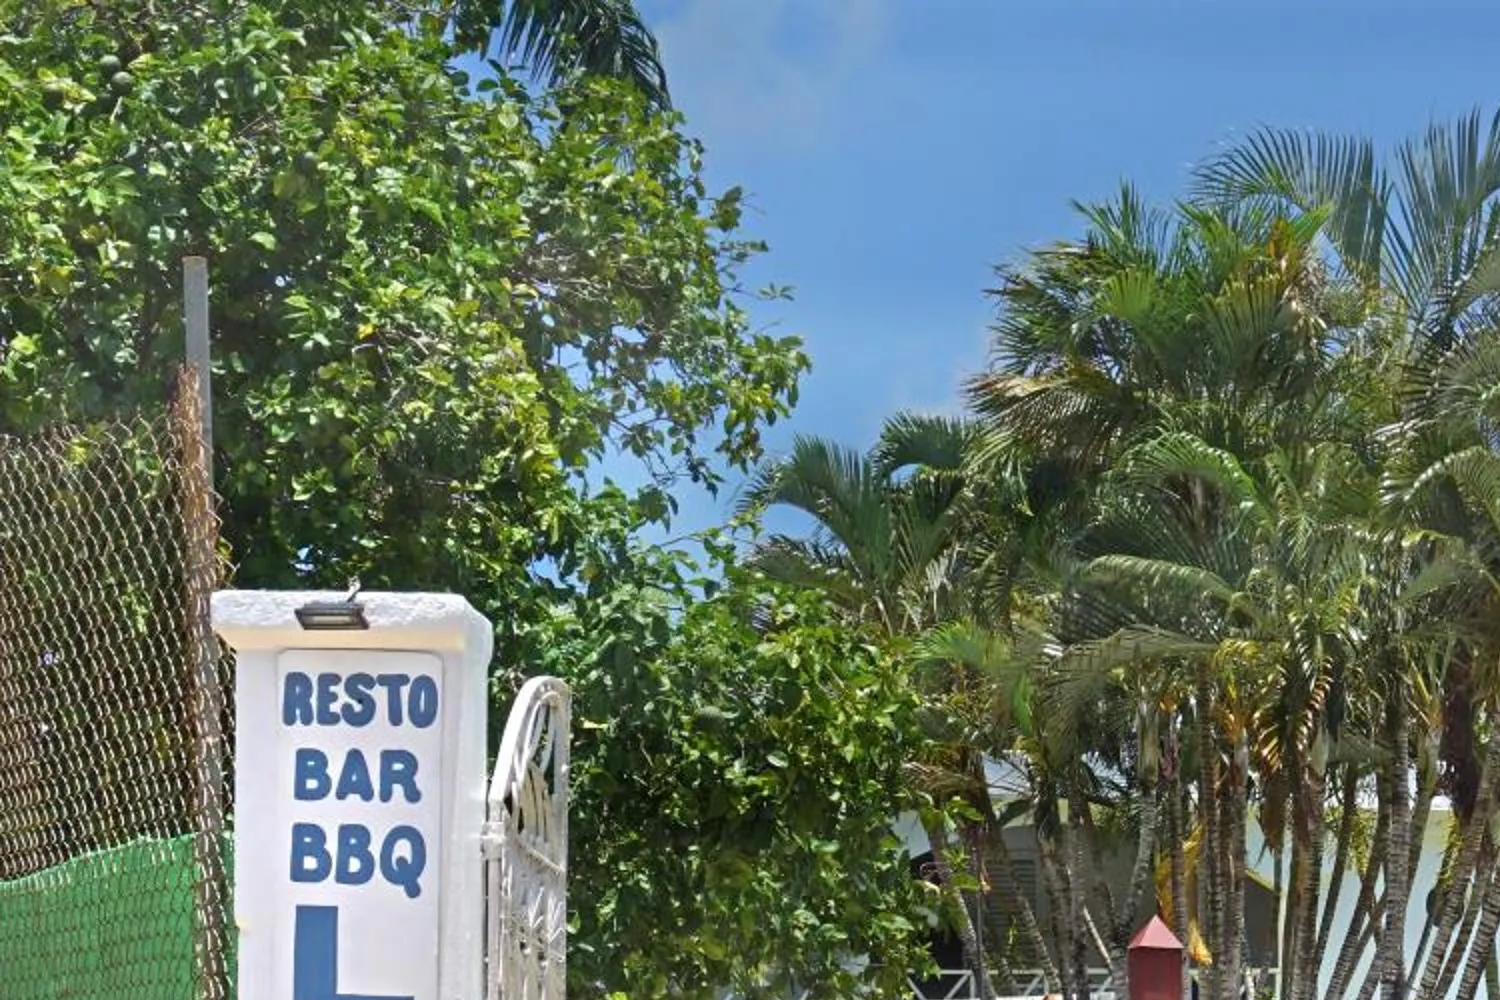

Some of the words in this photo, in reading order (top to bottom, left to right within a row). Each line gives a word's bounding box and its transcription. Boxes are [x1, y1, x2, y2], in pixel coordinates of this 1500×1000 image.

[282, 671, 439, 729] RESTO
[293, 747, 423, 804] BAR
[289, 821, 427, 899] BBQ
